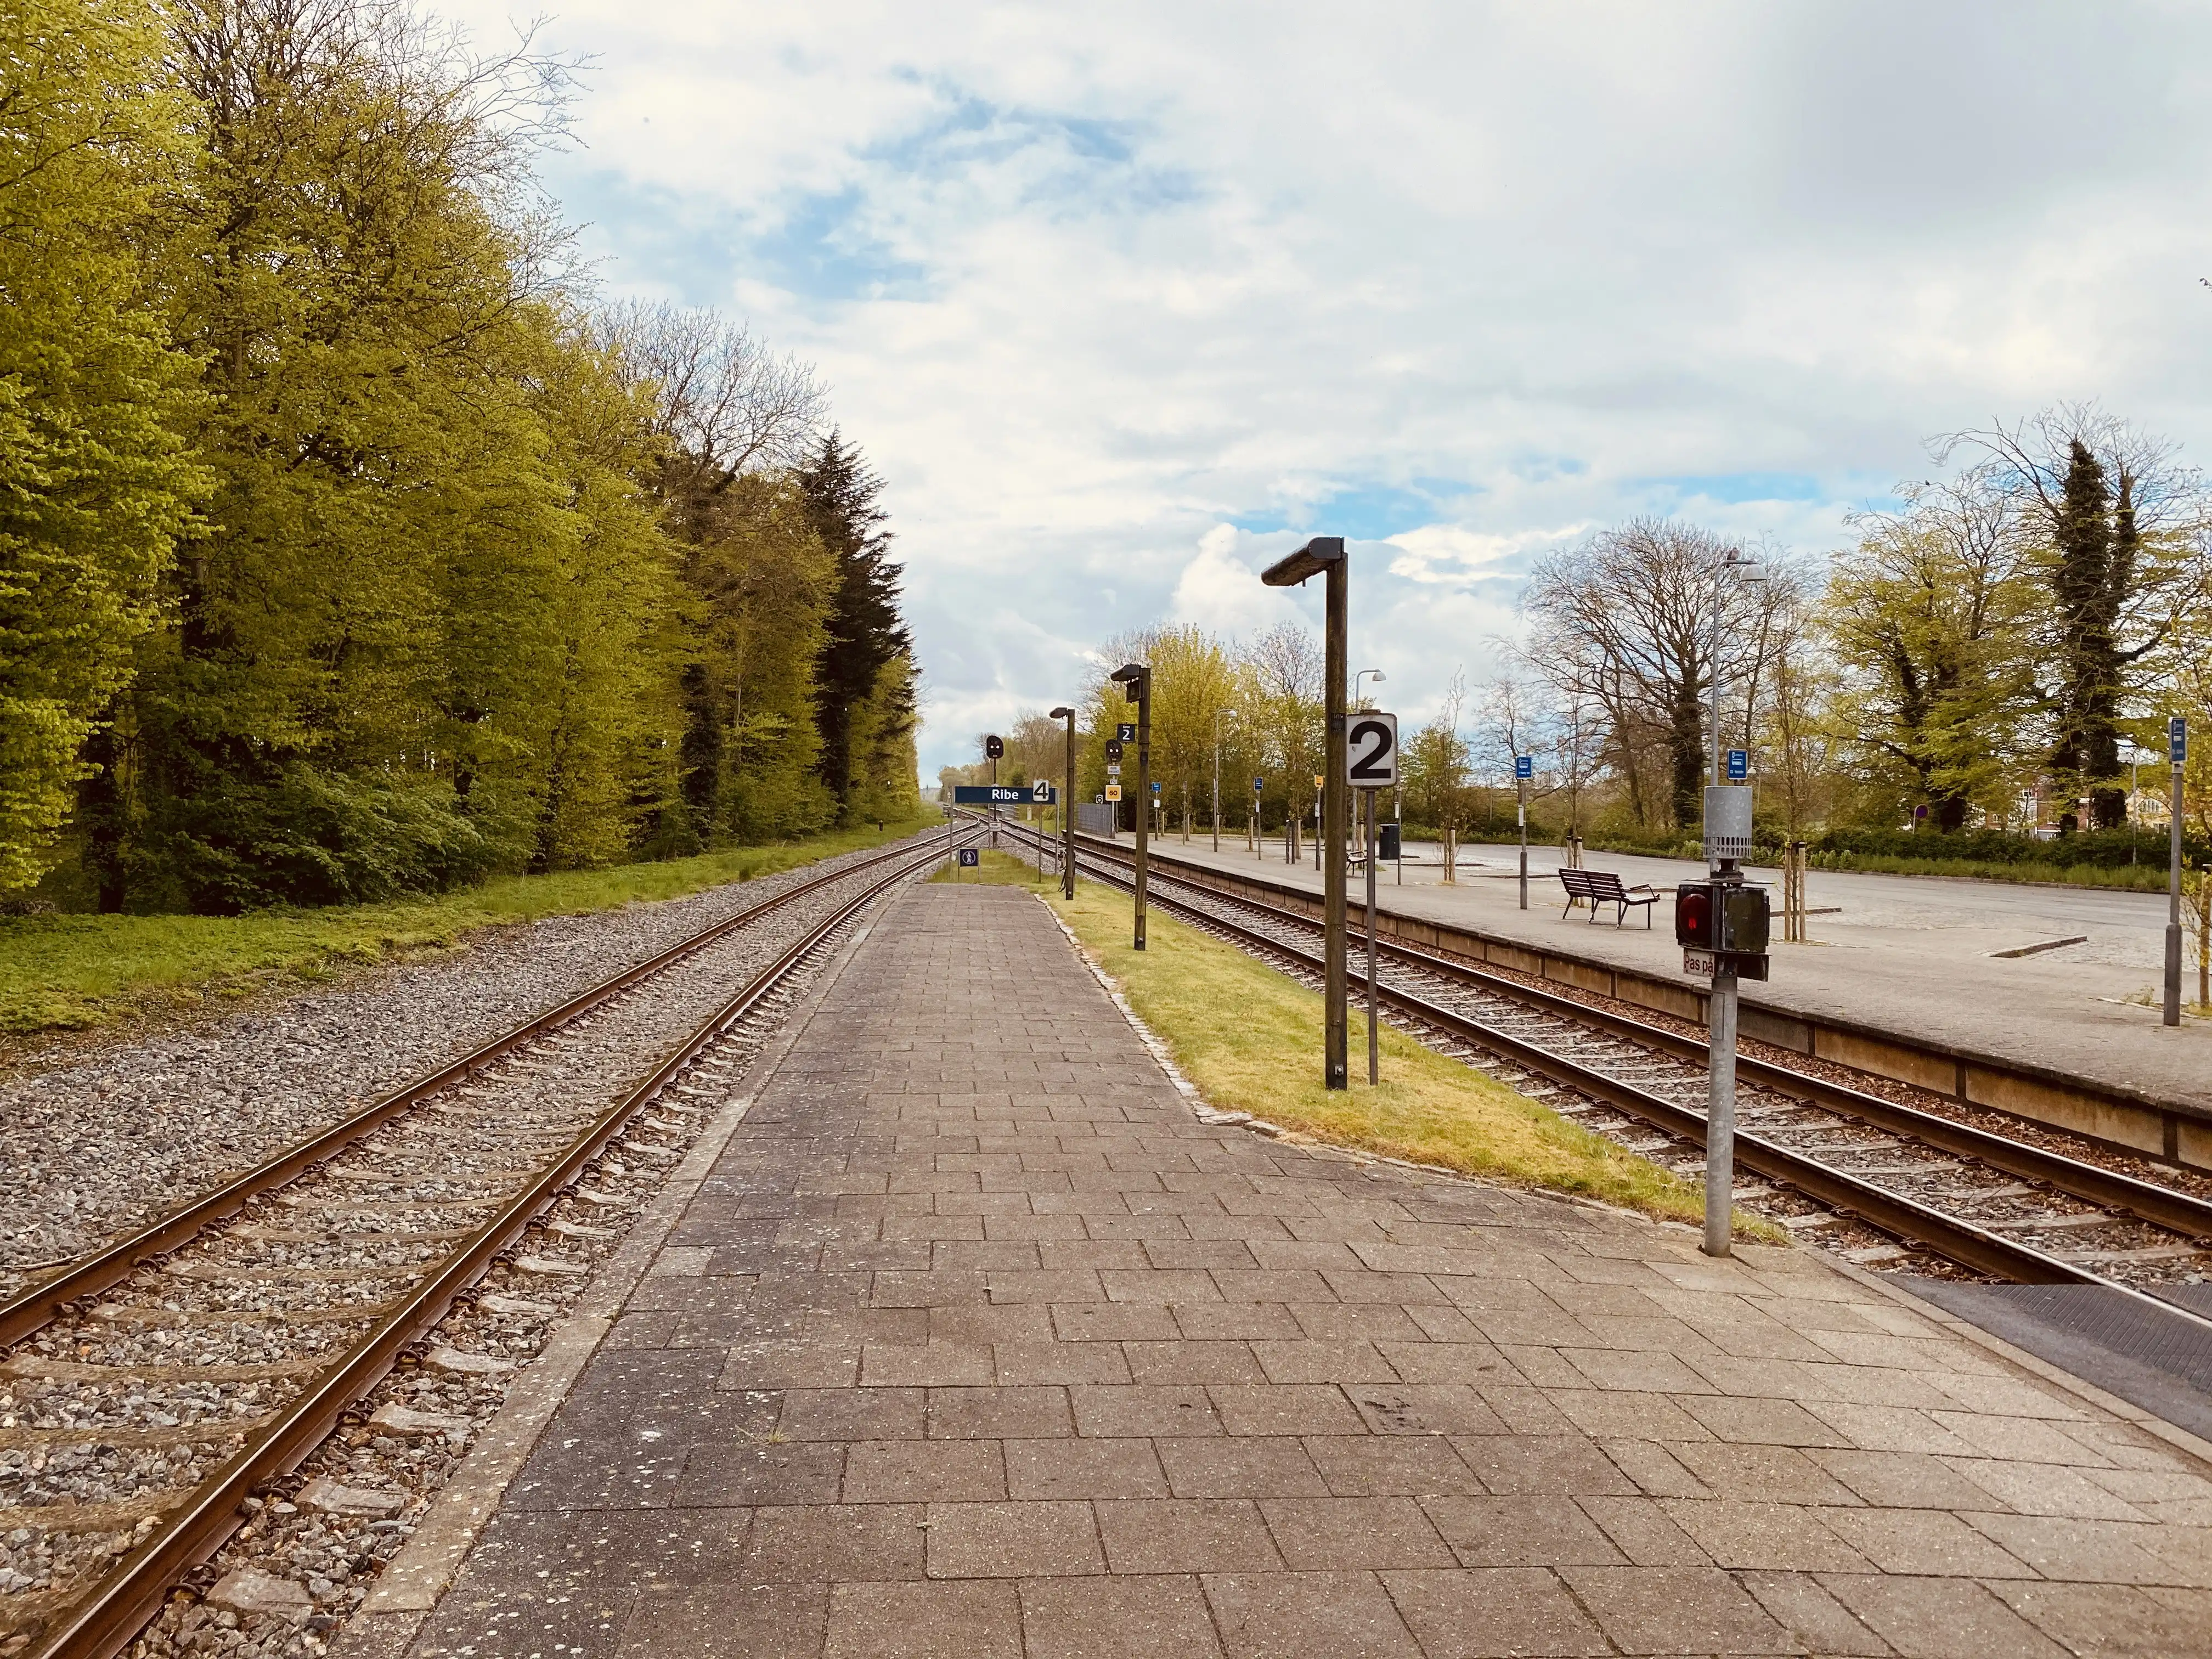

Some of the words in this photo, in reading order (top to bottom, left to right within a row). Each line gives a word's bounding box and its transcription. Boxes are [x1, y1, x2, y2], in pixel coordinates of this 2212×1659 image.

[1122, 729, 1130, 740] 2
[1350, 721, 1392, 779] 2
[992, 789, 1019, 800] Ribe
[1034, 782, 1048, 799] 4
[1684, 955, 1700, 970] Pas
[1702, 957, 1713, 975] på
